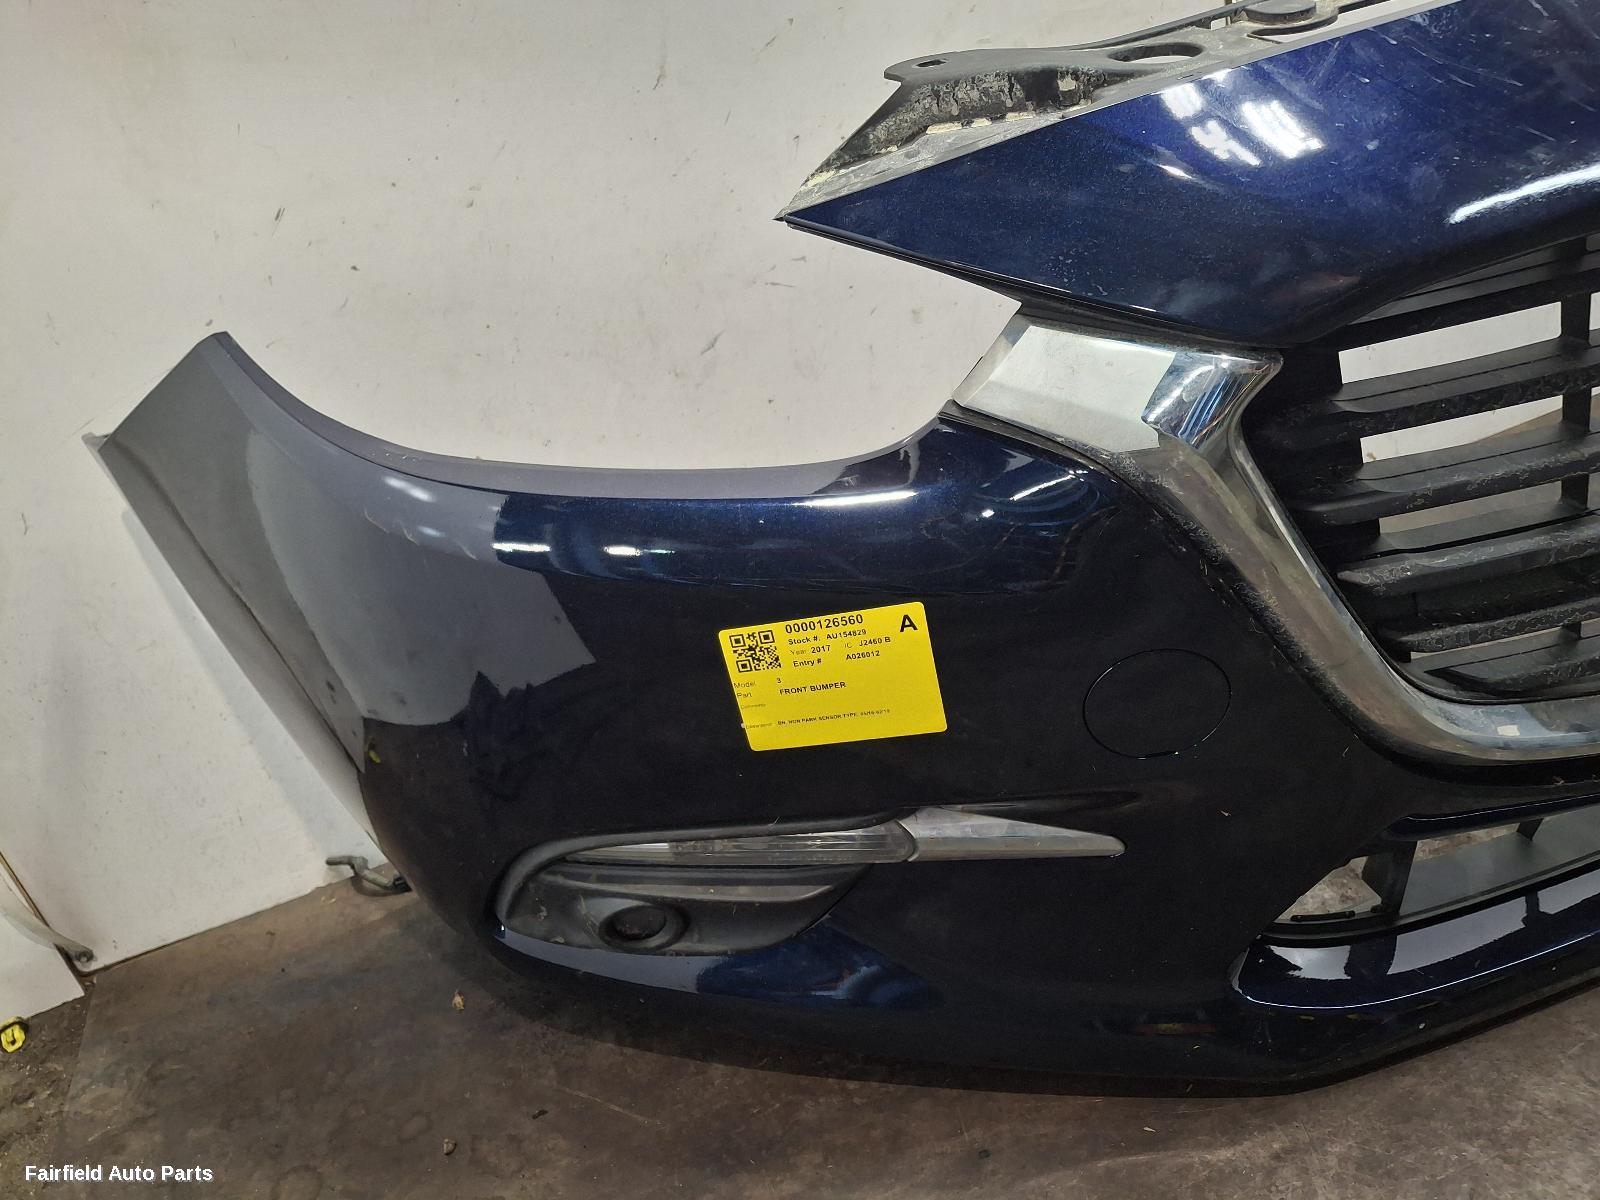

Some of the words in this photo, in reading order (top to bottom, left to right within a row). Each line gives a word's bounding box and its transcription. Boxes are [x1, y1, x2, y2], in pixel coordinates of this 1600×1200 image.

[785, 614, 863, 634] 0000126560
[900, 614, 918, 632] A
[788, 637, 811, 645] Stock
[826, 629, 867, 640] AU154829
[811, 644, 831, 654] 2017
[793, 660, 815, 668] Entry
[846, 650, 880, 660] A026012
[780, 686, 808, 695] FRONT
[810, 681, 846, 691] BUMPER
